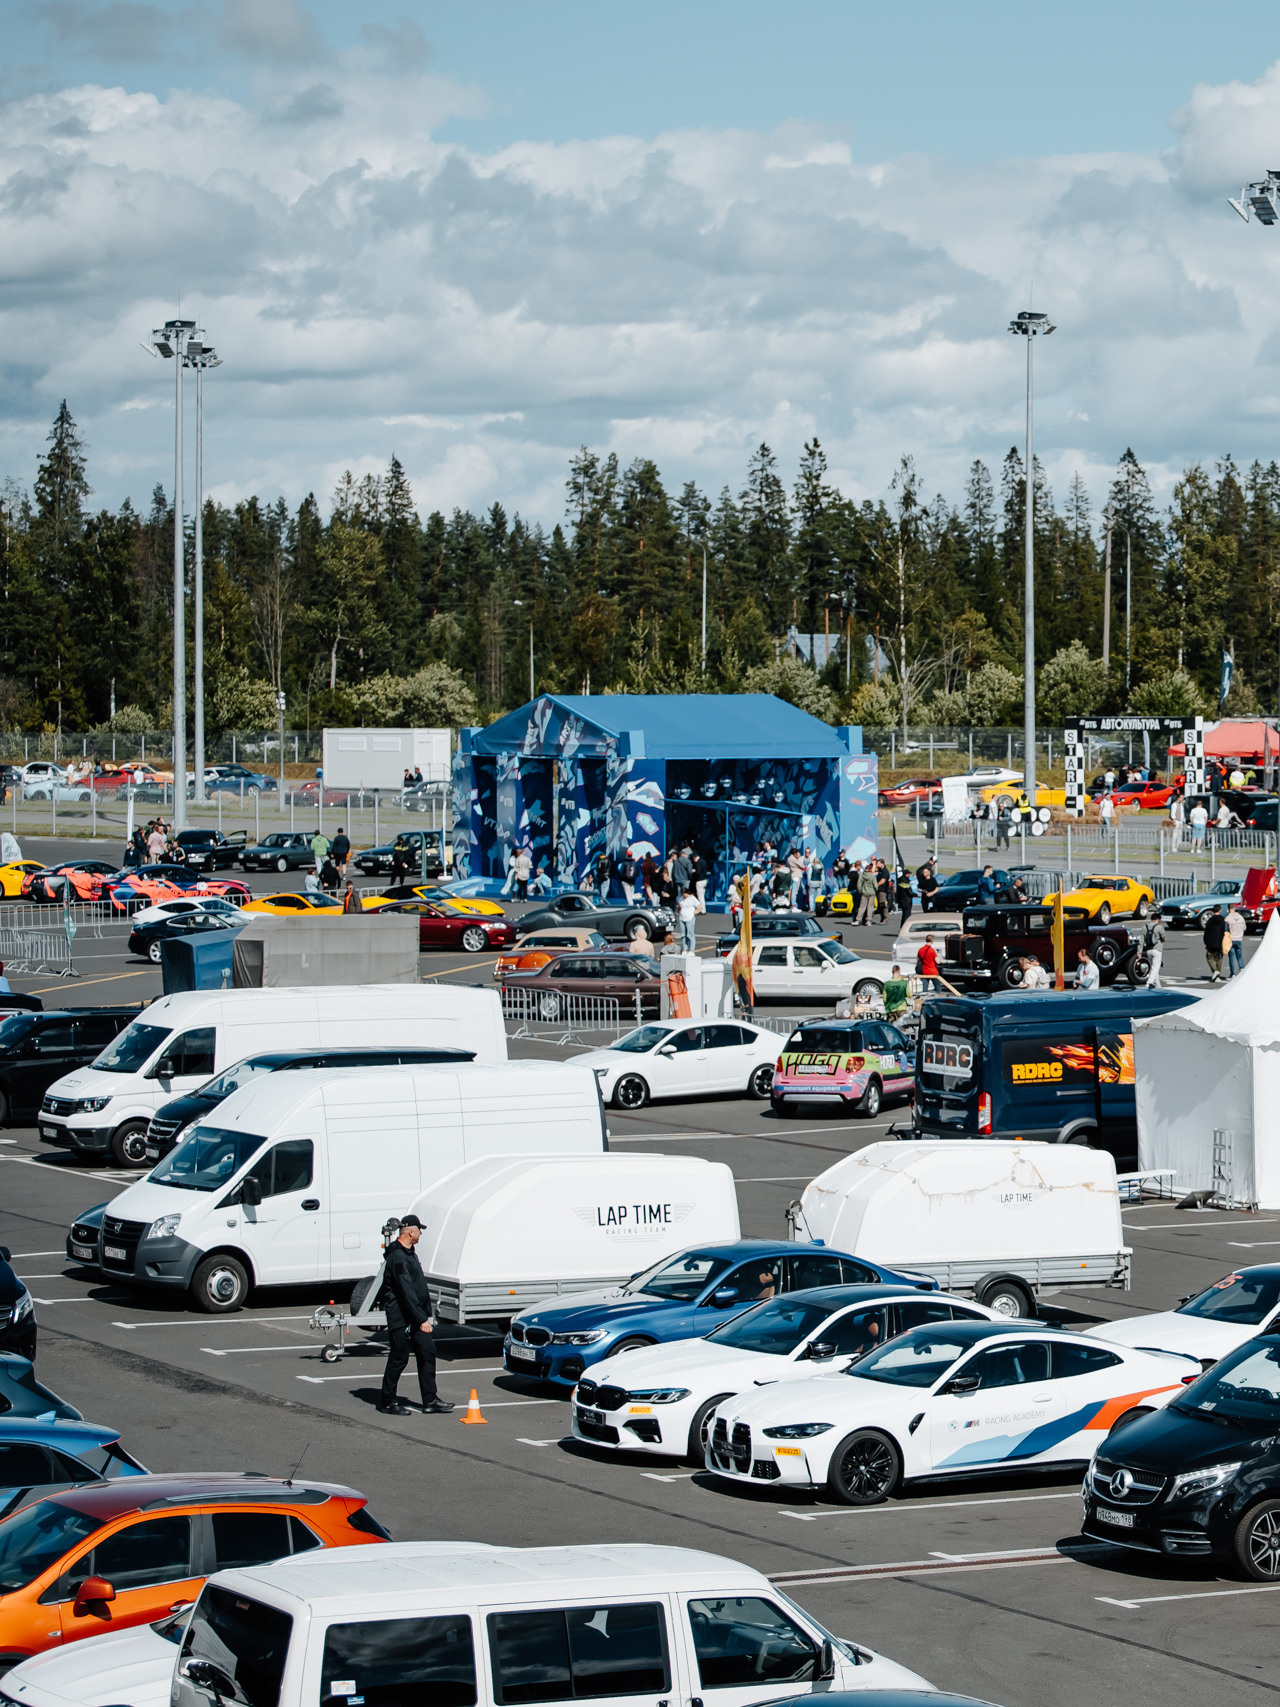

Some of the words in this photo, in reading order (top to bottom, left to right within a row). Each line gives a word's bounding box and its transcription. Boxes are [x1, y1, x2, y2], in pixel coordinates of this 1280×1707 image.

[1100, 718, 1161, 730] АВТОКУЛЬТУРА
[1067, 732, 1076, 796] START
[924, 1042, 972, 1070] RDRC
[1011, 1062, 1063, 1080] RDRC
[812, 1085, 841, 1093] equipment
[1000, 1194, 1014, 1203] LAP
[1016, 1193, 1033, 1202] TIME
[598, 1206, 628, 1226] LAP
[633, 1204, 672, 1224] TIME
[606, 1227, 638, 1235] RACING
[985, 1415, 1011, 1425] RACING
[1012, 1410, 1046, 1421] ACADEMY
